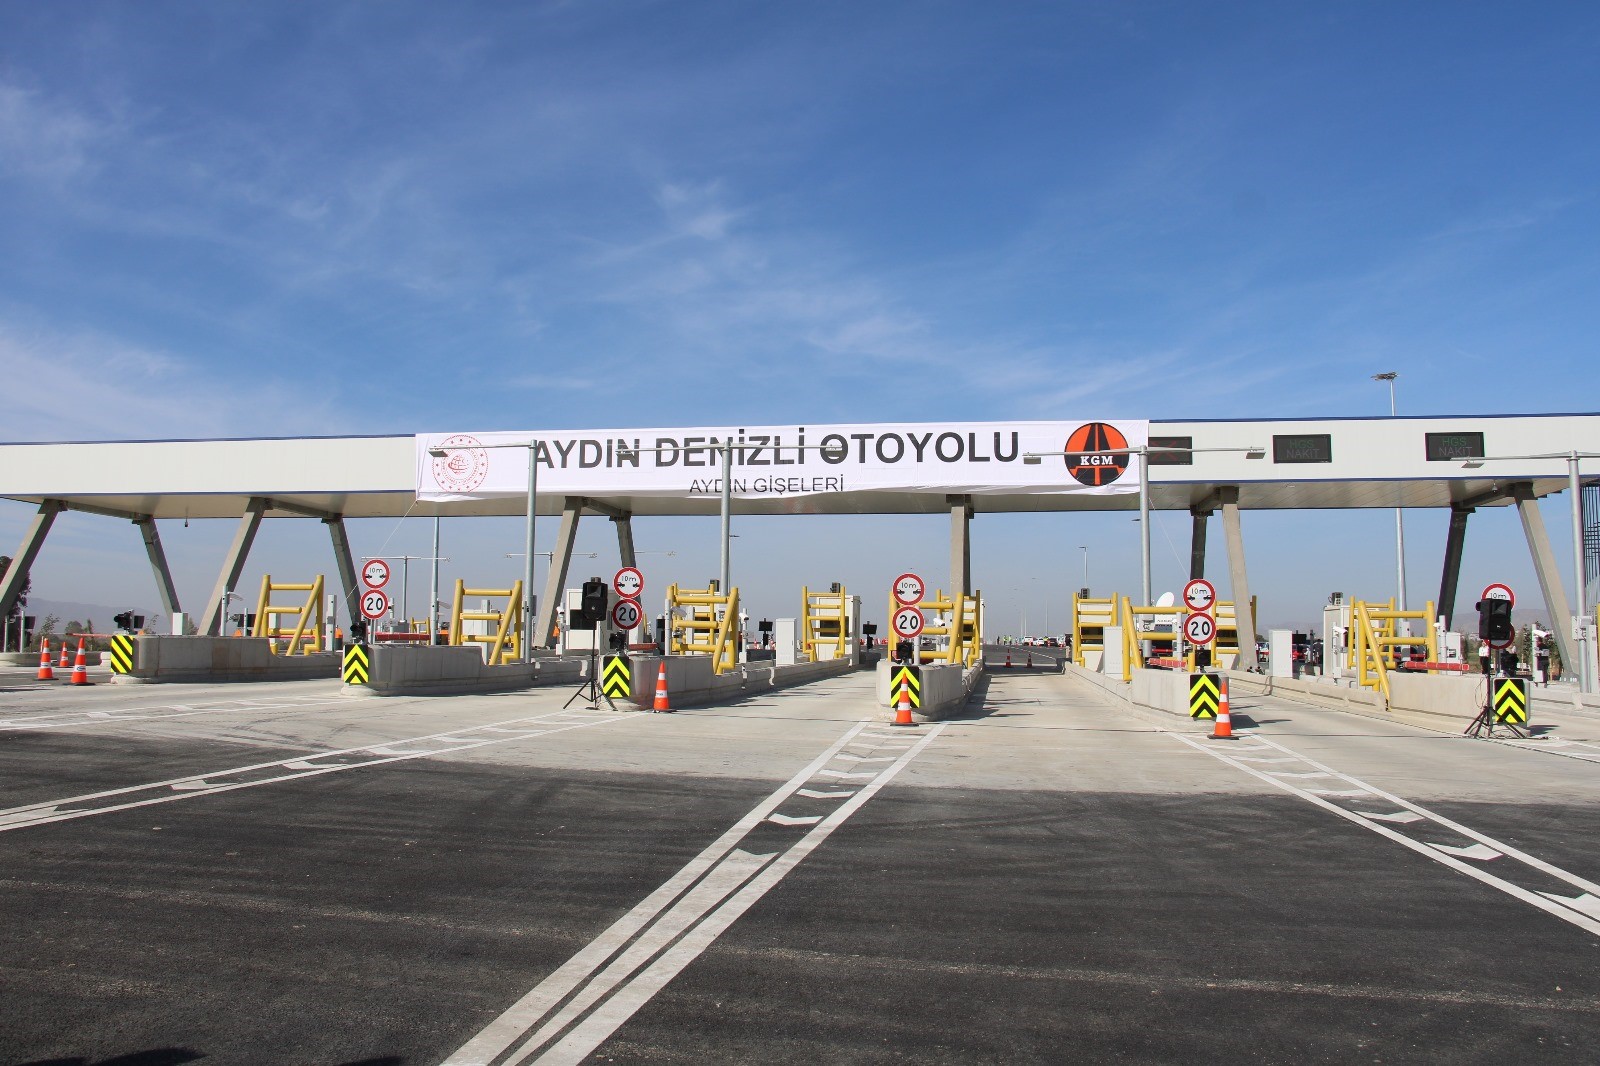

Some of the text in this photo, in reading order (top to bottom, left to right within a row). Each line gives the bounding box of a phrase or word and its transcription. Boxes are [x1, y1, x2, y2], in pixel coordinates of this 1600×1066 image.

[535, 427, 1018, 469] AYDIN DENİZLİ OTOYOLU
[1289, 439, 1314, 449] HGS
[1442, 437, 1467, 447] HGS
[1080, 455, 1114, 466] KGM
[753, 473, 844, 495] GİŞELERİ
[366, 597, 384, 611] 20
[618, 606, 637, 621] 20
[899, 614, 919, 629] 20
[1190, 621, 1211, 636] 20
